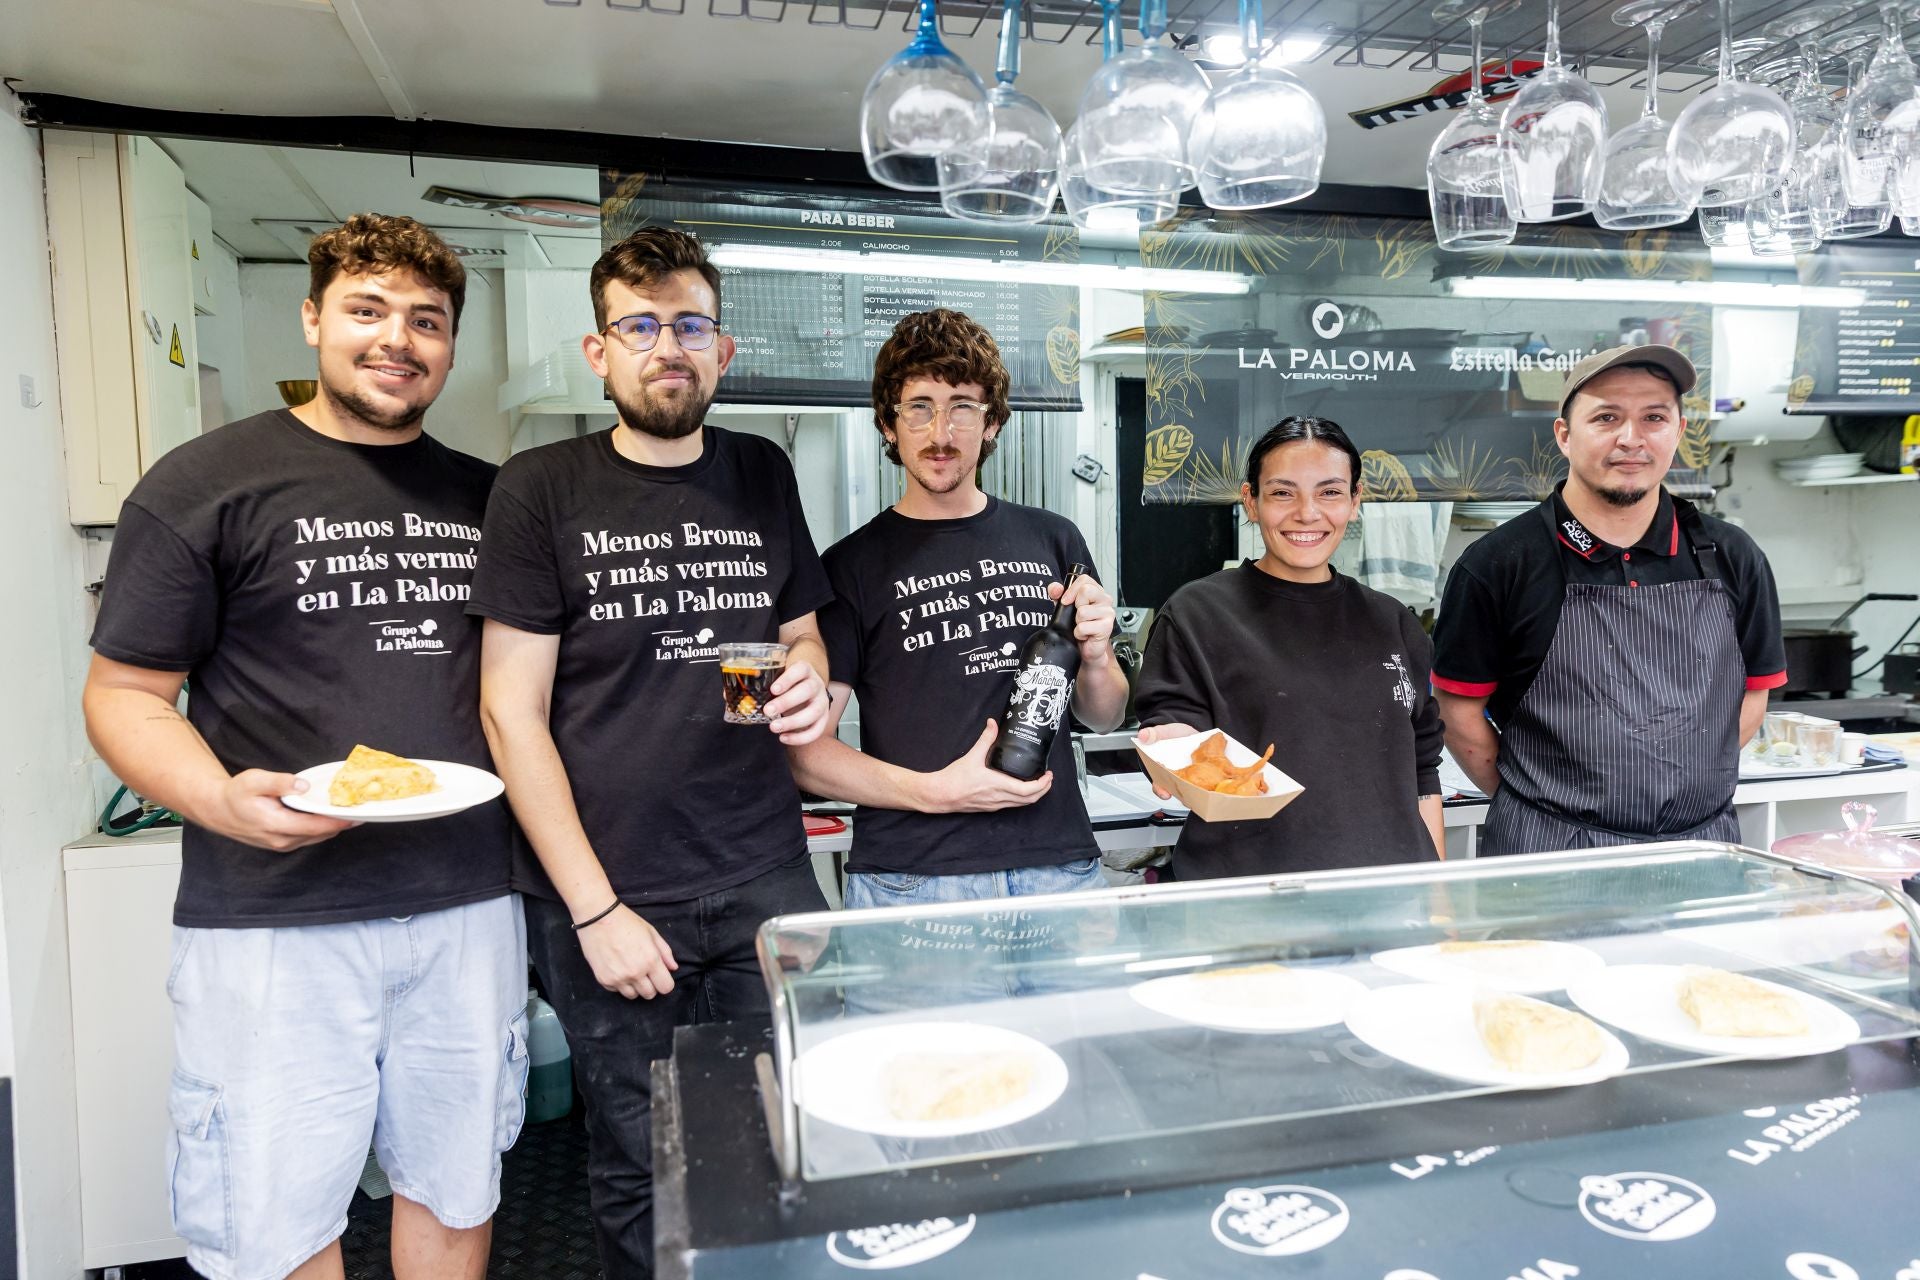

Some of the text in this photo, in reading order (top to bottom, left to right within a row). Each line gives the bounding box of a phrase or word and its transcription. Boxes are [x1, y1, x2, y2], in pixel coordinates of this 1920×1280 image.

[801, 211, 895, 229] PARA BEBER
[862, 242, 910, 251] CALIMOCHO
[863, 275, 900, 283] BOTELLA
[863, 286, 986, 298] BOTELLA VERMUTH MANCHADO
[863, 297, 974, 309] BOTELLA VERMUTH BLANCO
[733, 336, 768, 344] GLUTEN
[1238, 347, 1416, 372] LA PALOMA
[1450, 346, 1598, 372] Estrella Gali
[1280, 372, 1378, 381] VERMOUTH
[294, 512, 482, 544] Menos Broma
[581, 522, 763, 556] Menos Broma
[295, 545, 478, 584] y más vermú
[585, 554, 768, 595] y más vermús
[894, 559, 1053, 600] Menos Broma
[297, 577, 471, 612] en La Palo
[590, 587, 773, 621] en La Paloma
[899, 580, 1052, 630] y más vermú
[382, 625, 418, 637] Grupo
[903, 605, 1052, 652] en La Palom
[376, 636, 444, 651] La Paloma
[661, 635, 693, 647] Grupo
[656, 646, 719, 660] La Paloma
[968, 650, 998, 662] Grupo
[964, 664, 980, 676] La
[1726, 1139, 1782, 1166] LA
[1389, 1154, 1448, 1180] LA
